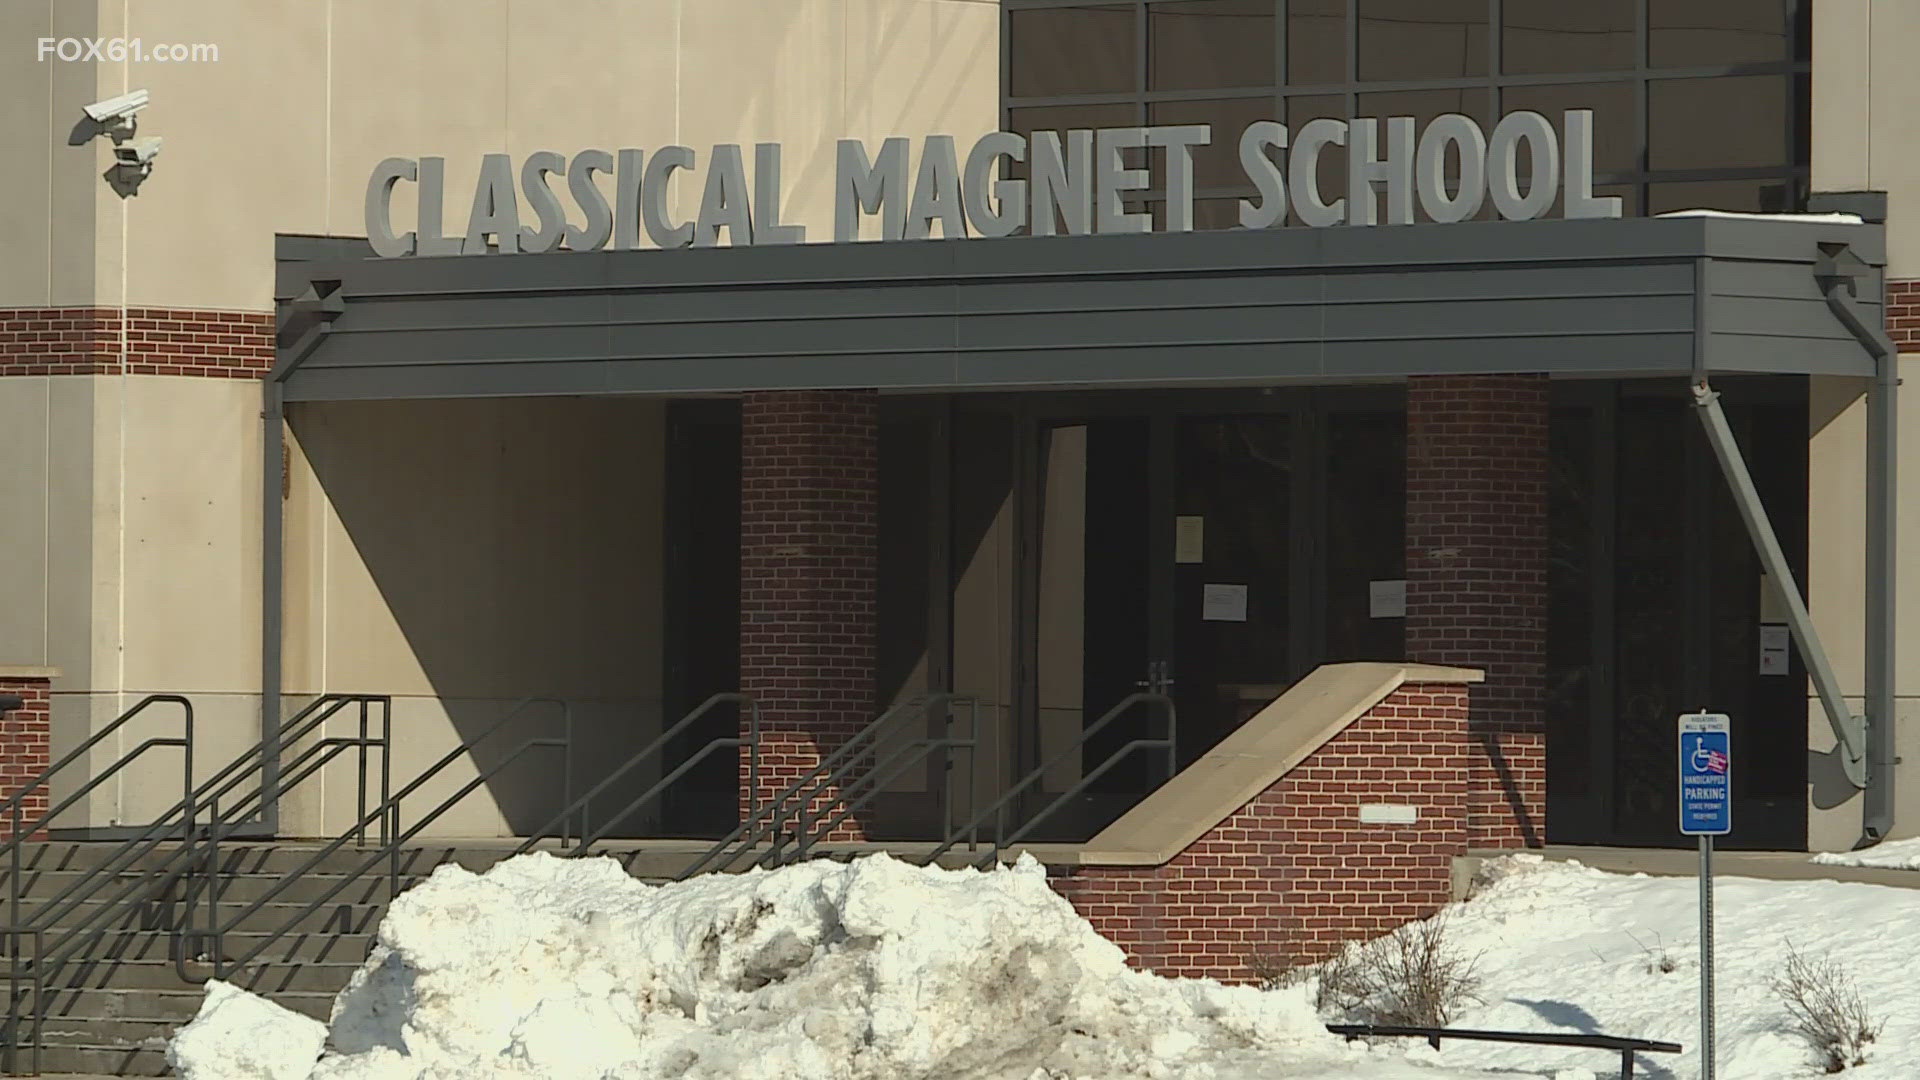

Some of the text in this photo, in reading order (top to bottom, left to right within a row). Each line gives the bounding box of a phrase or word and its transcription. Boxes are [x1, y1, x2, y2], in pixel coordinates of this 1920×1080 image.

[365, 109, 1623, 257] CLASSICAL MAGNET SCHOOL
[1684, 775, 1726, 785] HANDICAPPED
[1685, 788, 1725, 800] PARKING
